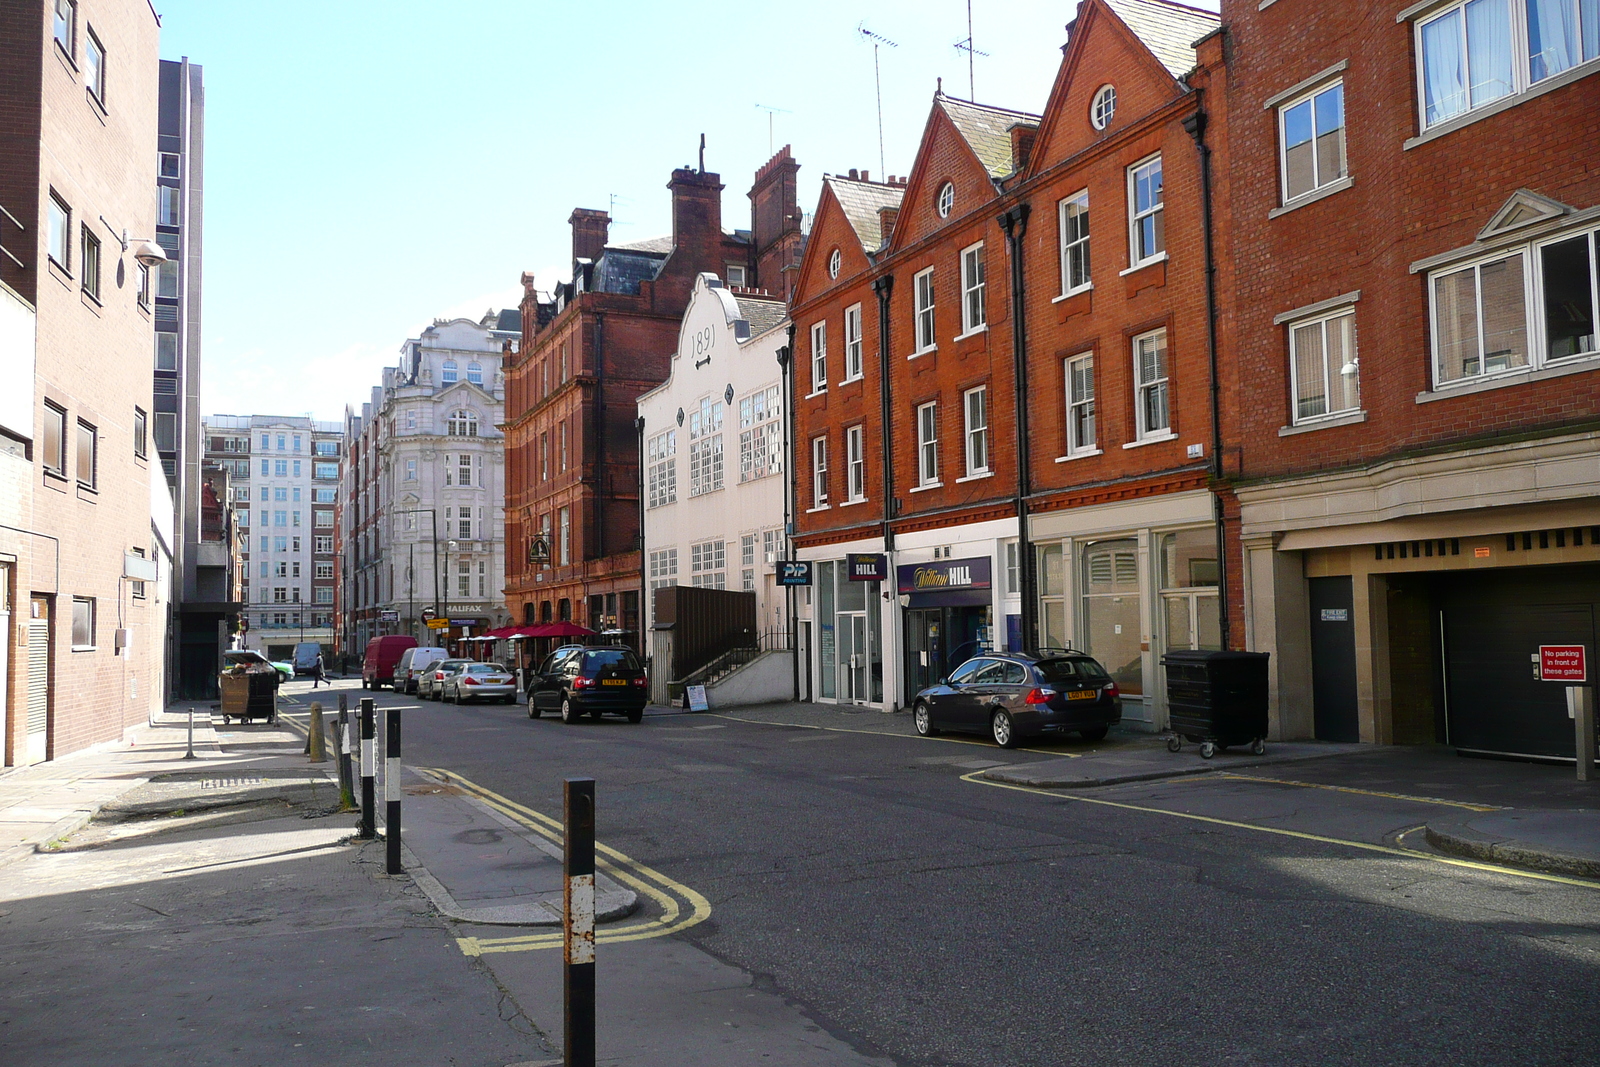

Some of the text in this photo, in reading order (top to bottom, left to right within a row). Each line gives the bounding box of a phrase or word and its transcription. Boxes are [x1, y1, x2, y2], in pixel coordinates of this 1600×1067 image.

[691, 324, 716, 359] 1891
[855, 564, 877, 576] HILL
[914, 565, 972, 590] William HILL
